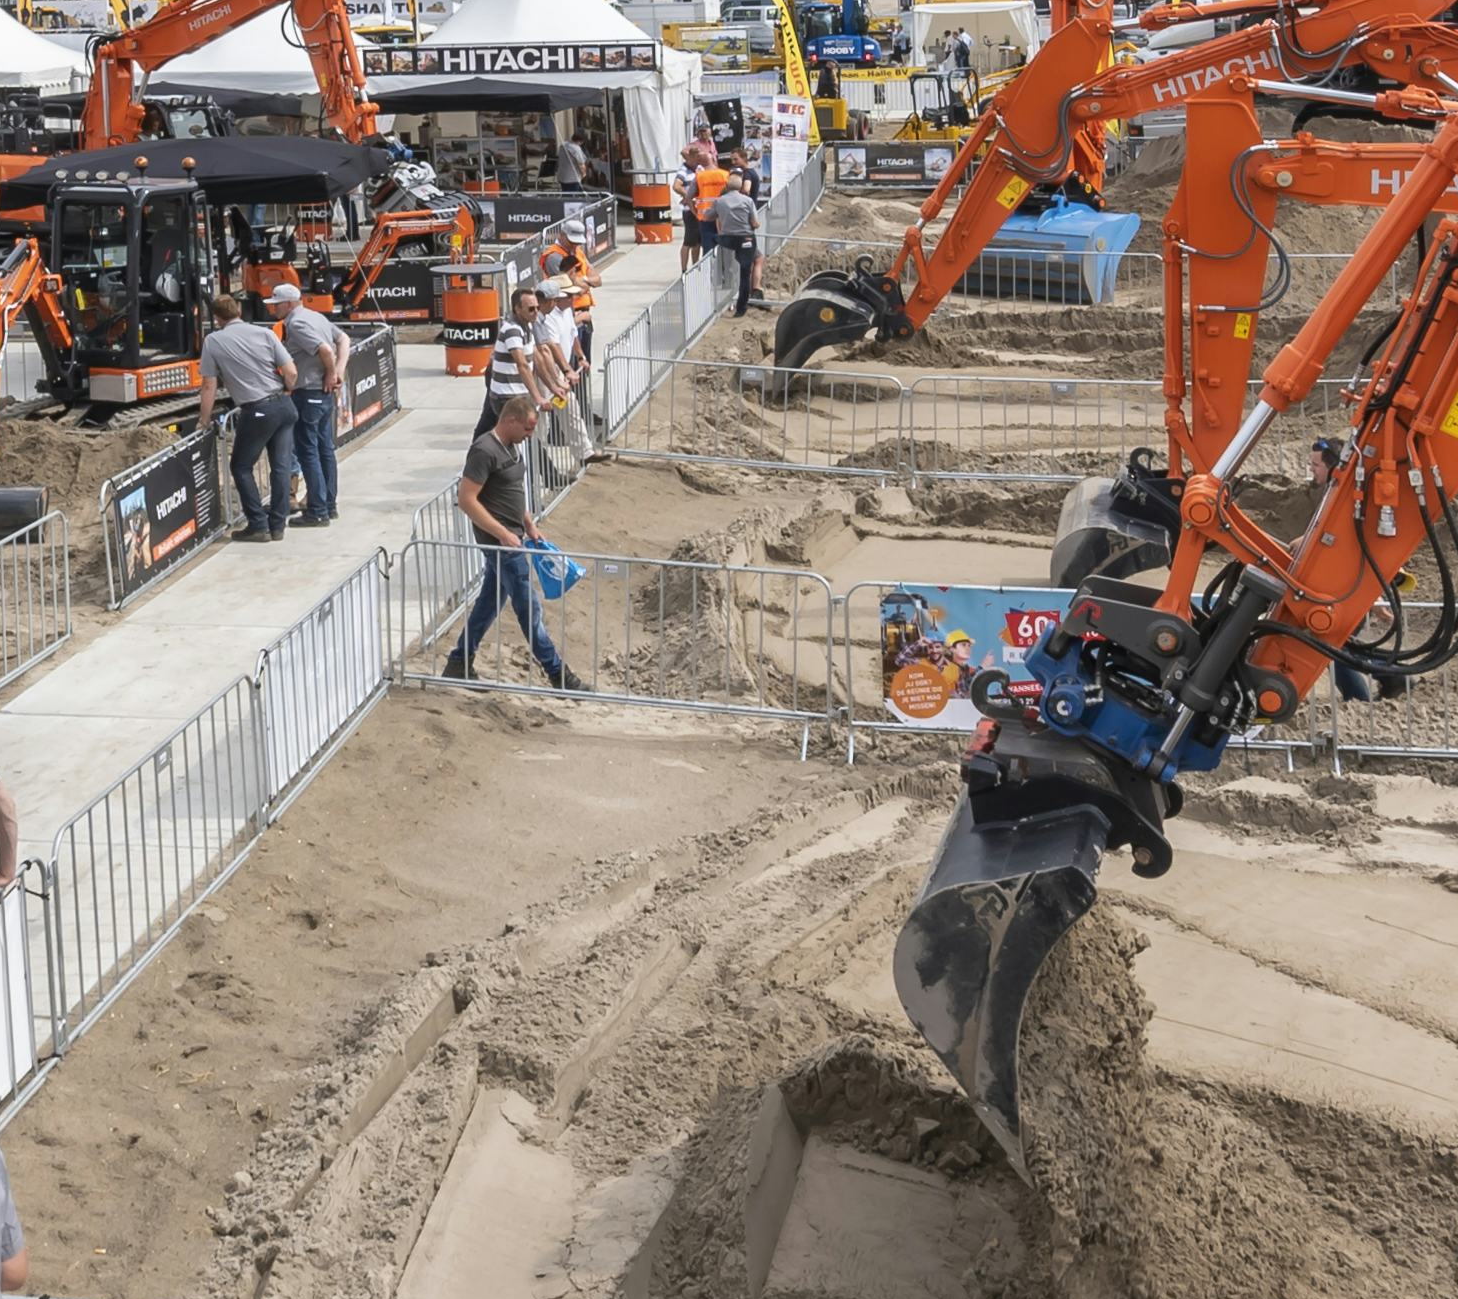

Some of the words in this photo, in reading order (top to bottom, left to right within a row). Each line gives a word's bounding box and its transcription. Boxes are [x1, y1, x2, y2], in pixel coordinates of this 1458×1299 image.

[188, 3, 232, 31] HITACHI
[443, 47, 575, 72] HITACHI
[867, 69, 893, 78] Halle
[895, 68, 909, 77] BV
[1152, 44, 1279, 103] HITACHI
[877, 157, 914, 166] HITACHI
[508, 214, 552, 223] HITACHI
[356, 373, 376, 396] HITACHI
[156, 487, 187, 521] HITACHI
